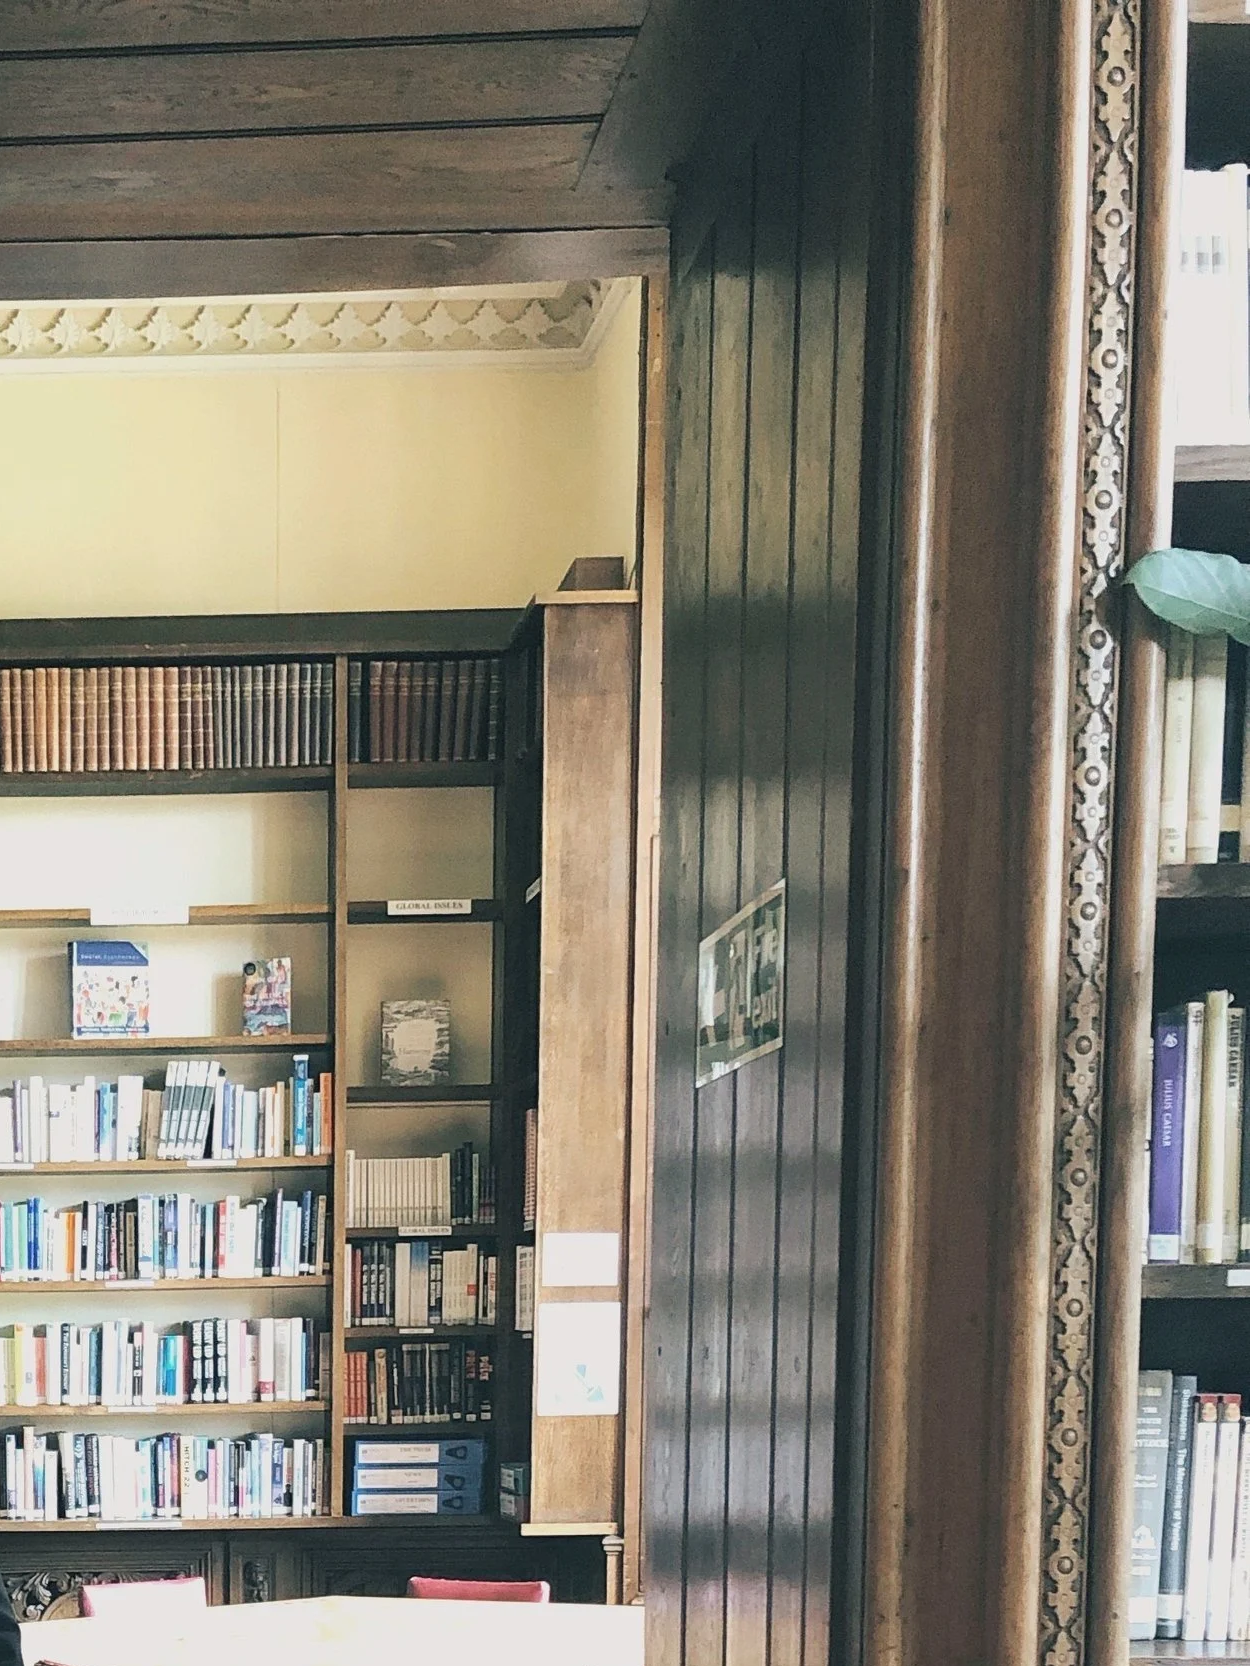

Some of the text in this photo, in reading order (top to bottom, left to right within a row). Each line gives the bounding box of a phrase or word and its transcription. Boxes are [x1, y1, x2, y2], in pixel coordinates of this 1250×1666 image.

[395, 901, 464, 910] GLOBAL ISSUES
[1161, 1112, 1173, 1147] CAESAR
[1170, 1389, 1191, 1551] Shakespeare The Merchant of Venice
